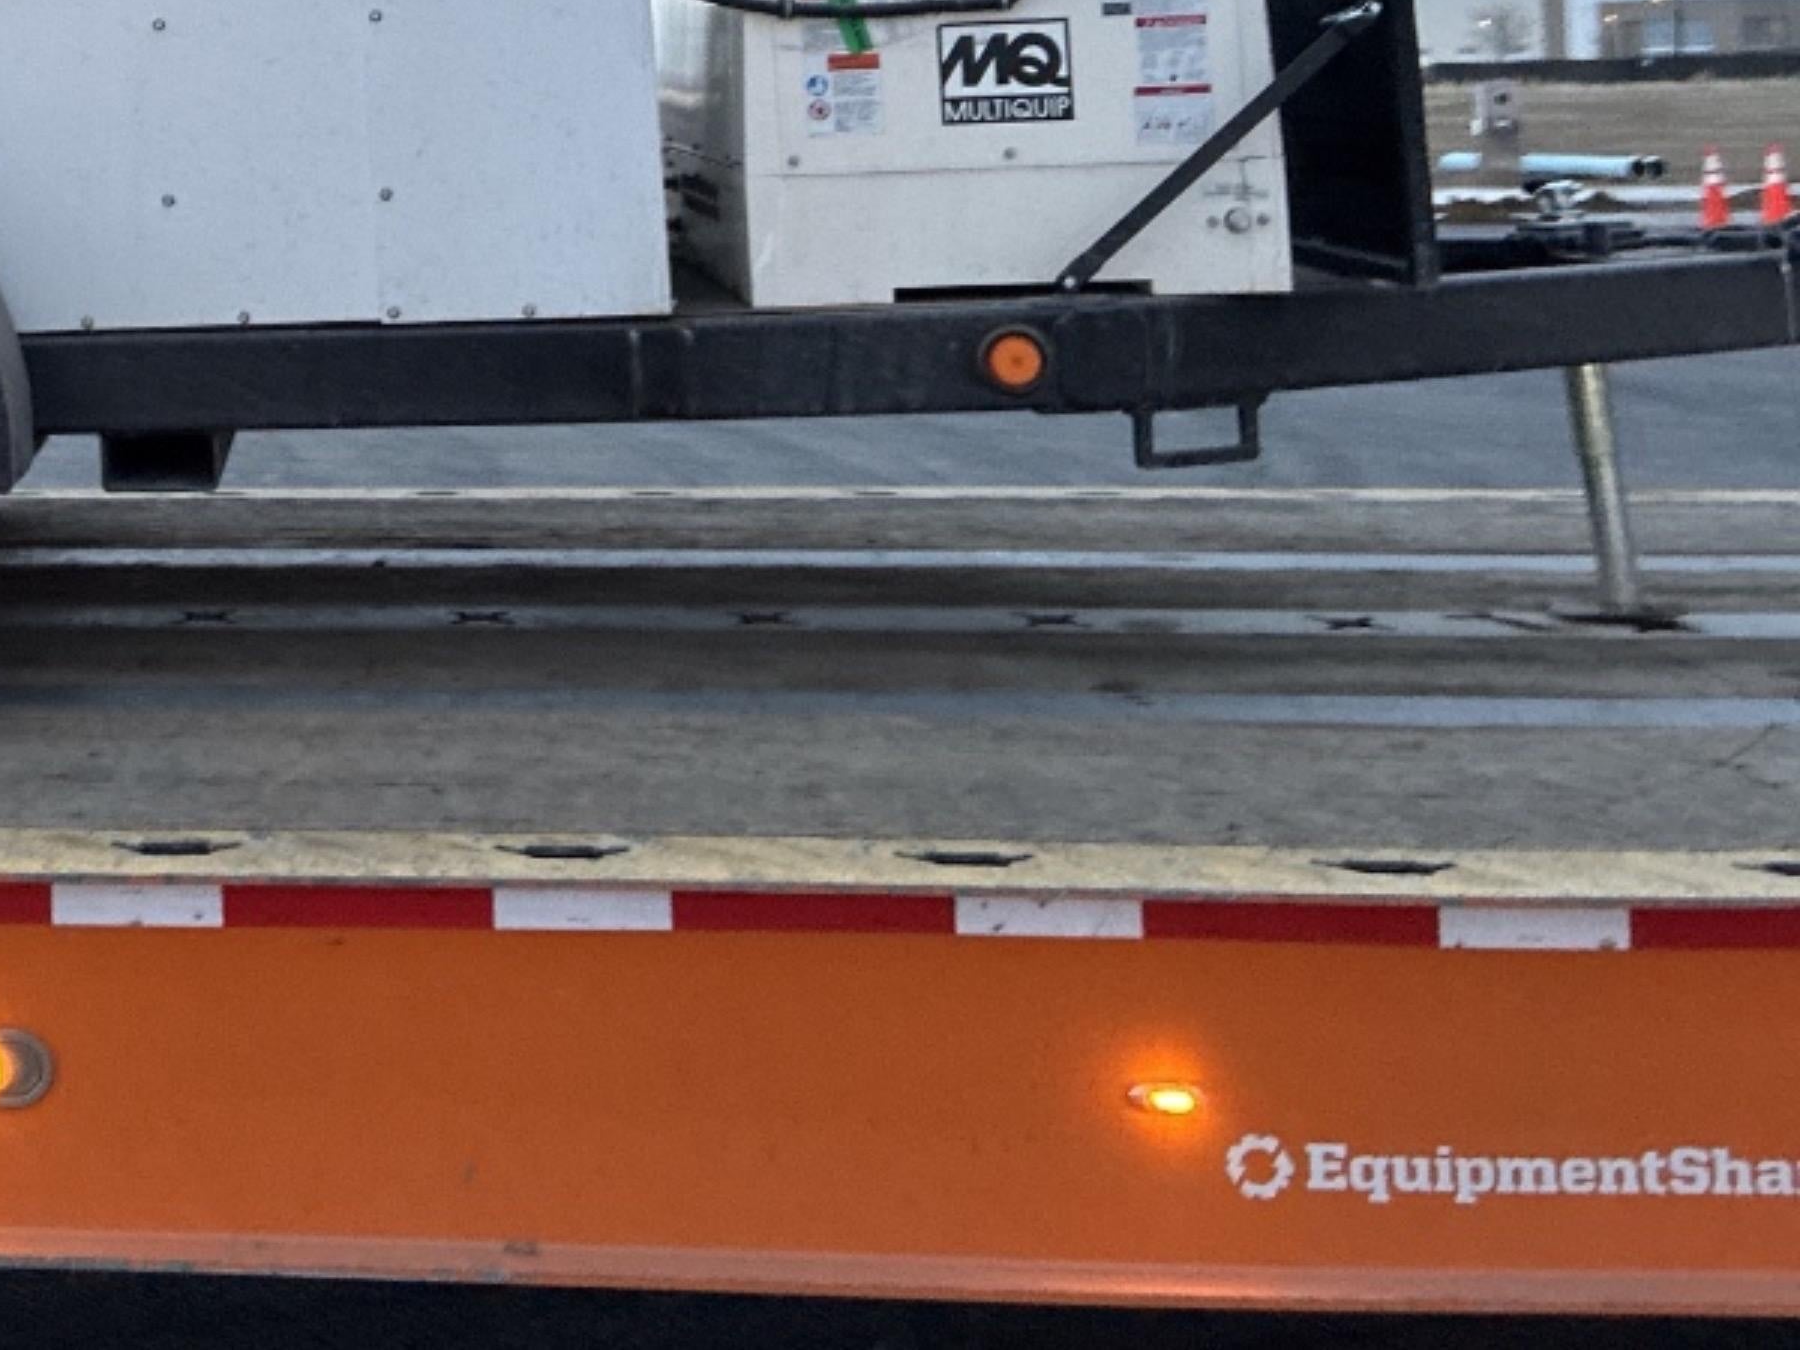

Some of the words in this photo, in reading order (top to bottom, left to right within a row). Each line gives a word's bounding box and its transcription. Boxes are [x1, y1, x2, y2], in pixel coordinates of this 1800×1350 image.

[942, 32, 1072, 87] MQ
[944, 97, 1071, 121] MULTIQUIP
[1305, 1143, 1800, 1204] EquipmentSha
